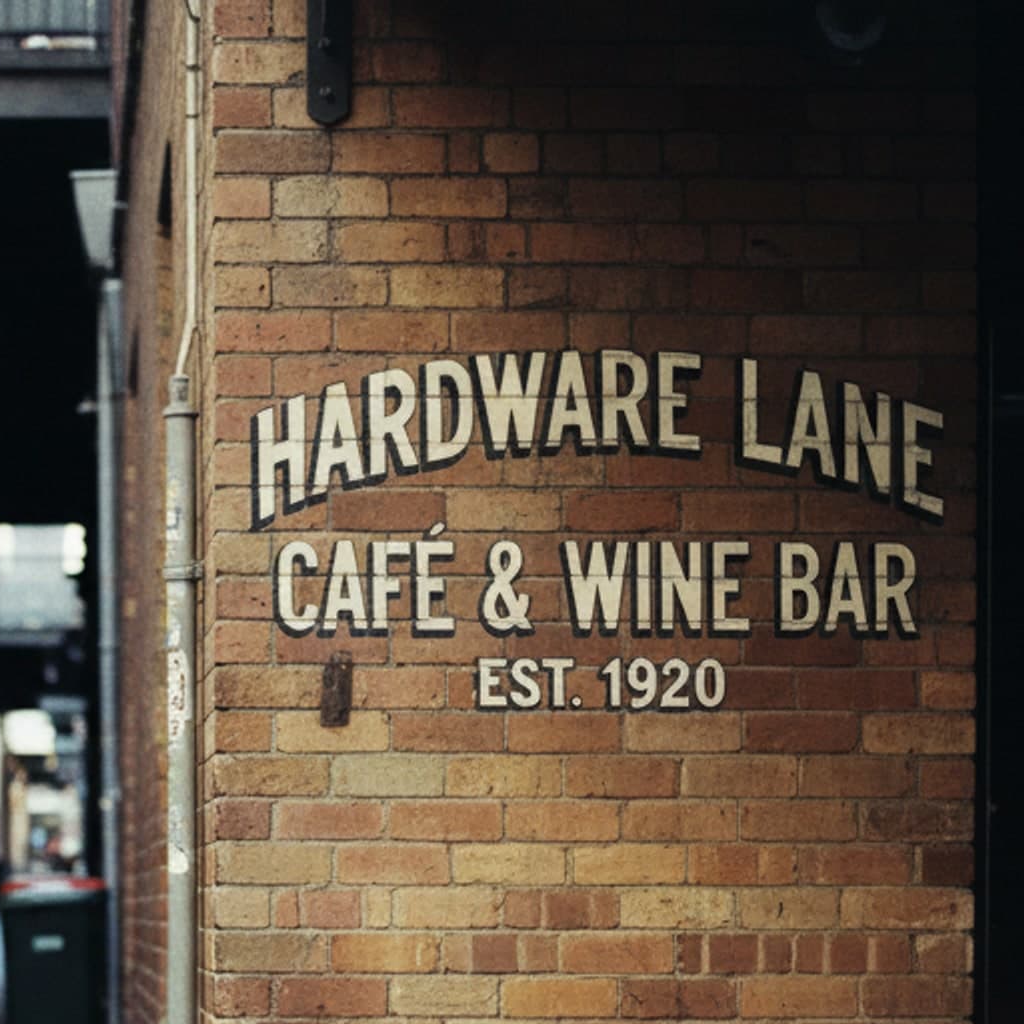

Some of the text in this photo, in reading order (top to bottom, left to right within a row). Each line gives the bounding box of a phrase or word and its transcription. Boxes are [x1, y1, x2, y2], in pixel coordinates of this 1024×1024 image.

[254, 350, 944, 524] HARDWARE LANE
[276, 522, 919, 633] CAFÉ & WINE BAR
[477, 657, 726, 709] EST. 1920
